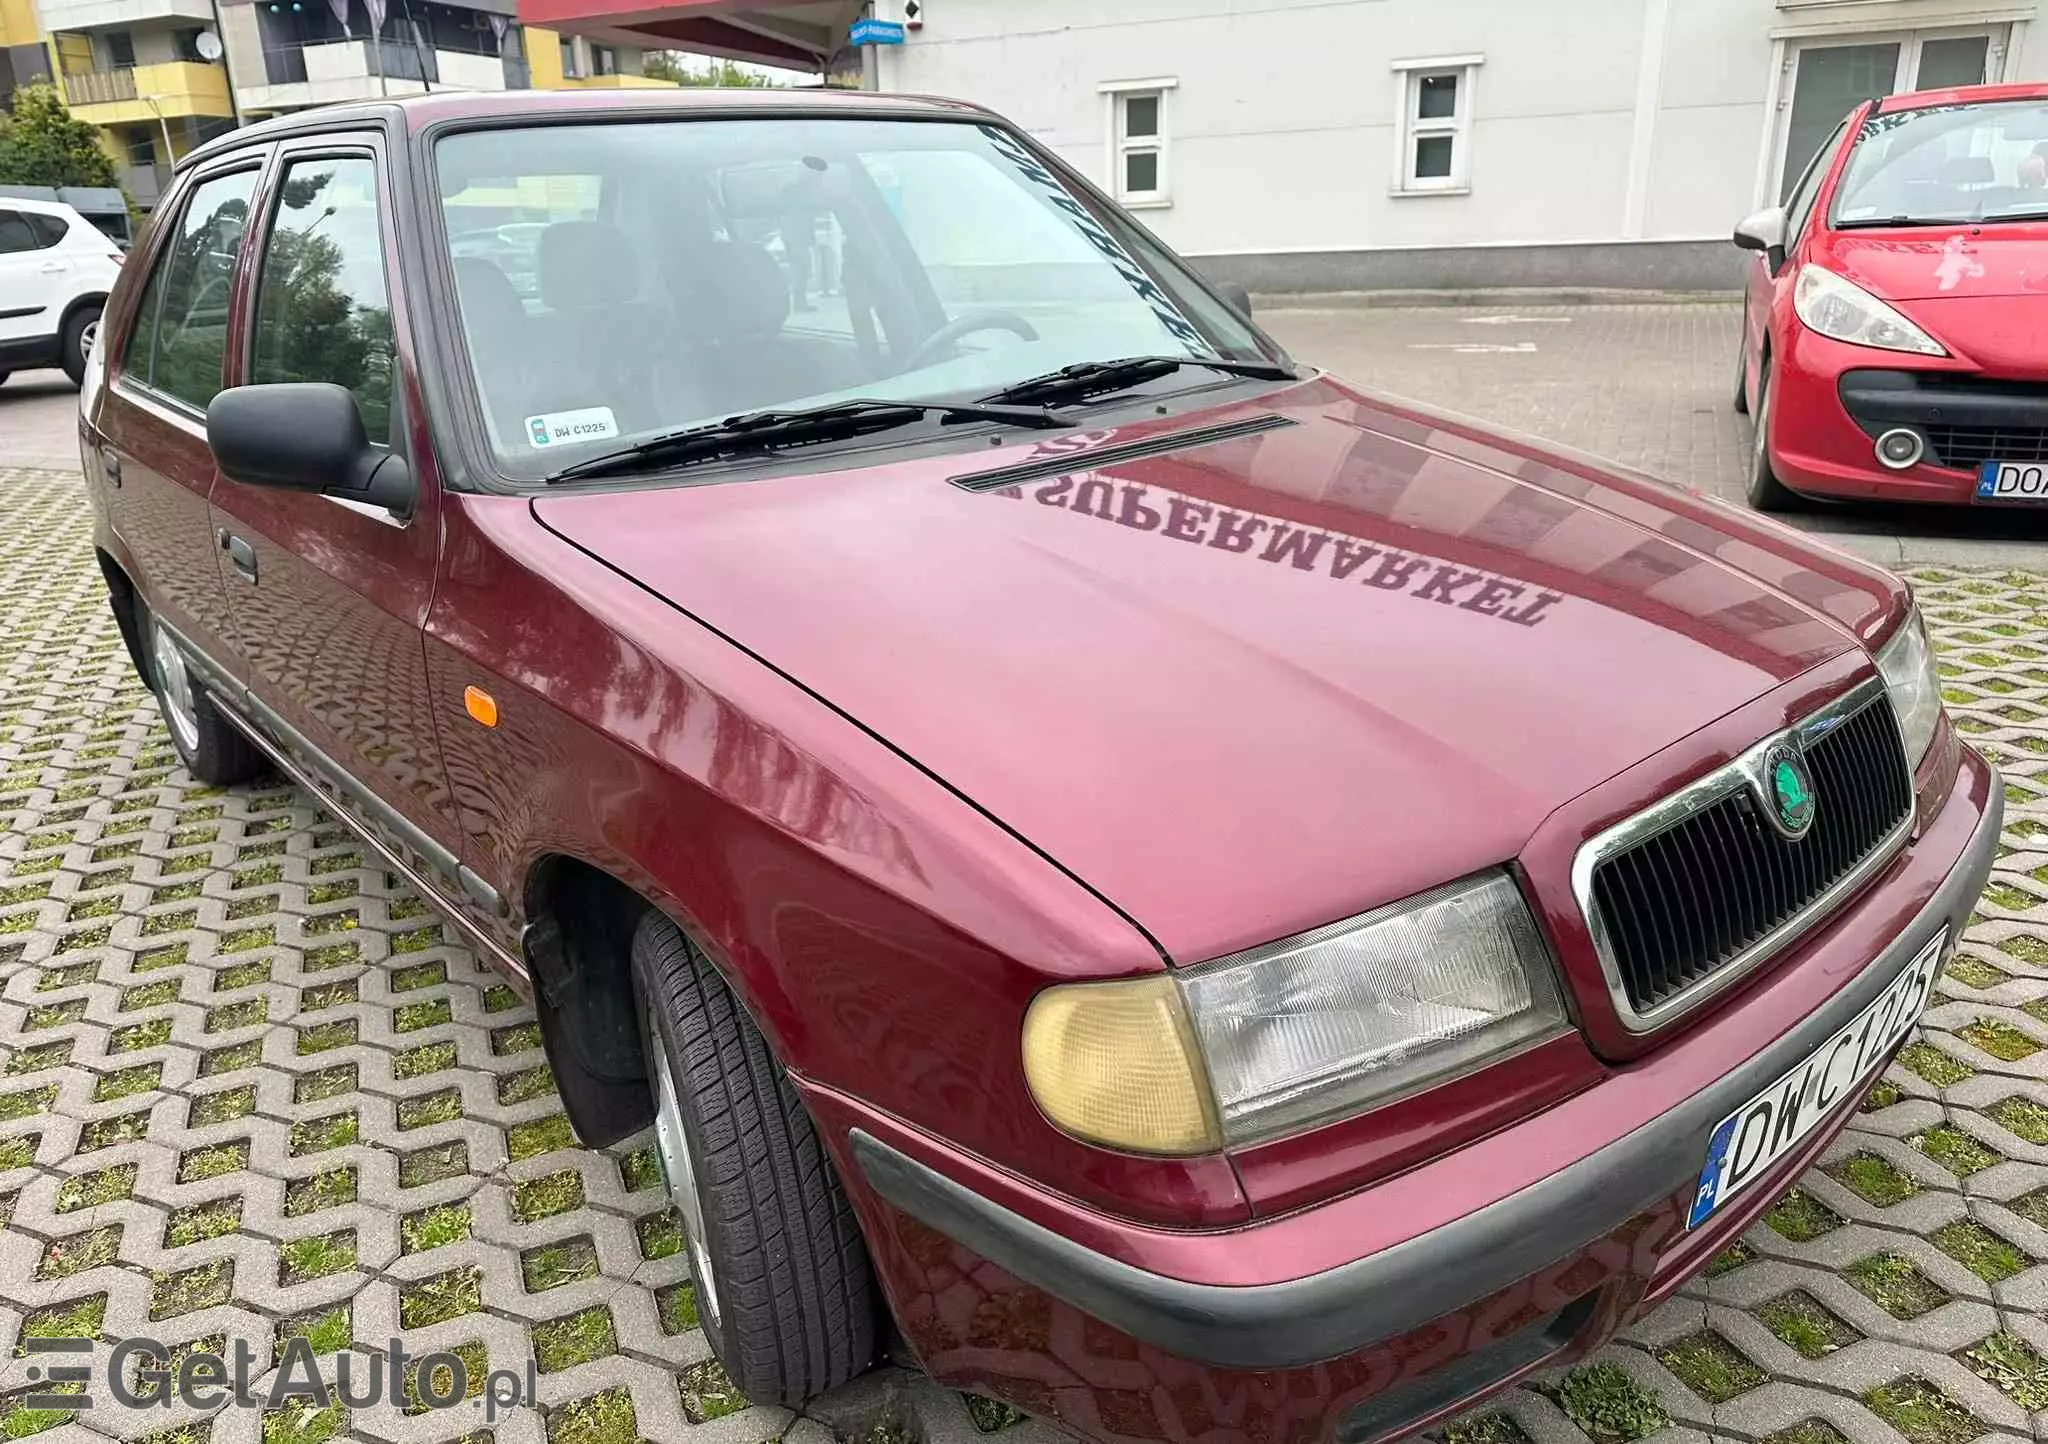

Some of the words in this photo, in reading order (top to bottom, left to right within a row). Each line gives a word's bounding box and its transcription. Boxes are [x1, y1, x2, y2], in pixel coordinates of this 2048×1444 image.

[554, 427, 570, 438] DW
[573, 422, 606, 435] C1225
[1726, 1062, 1813, 1190] DW
[1817, 948, 1938, 1111] C1225
[1698, 1182, 1715, 1203] PL
